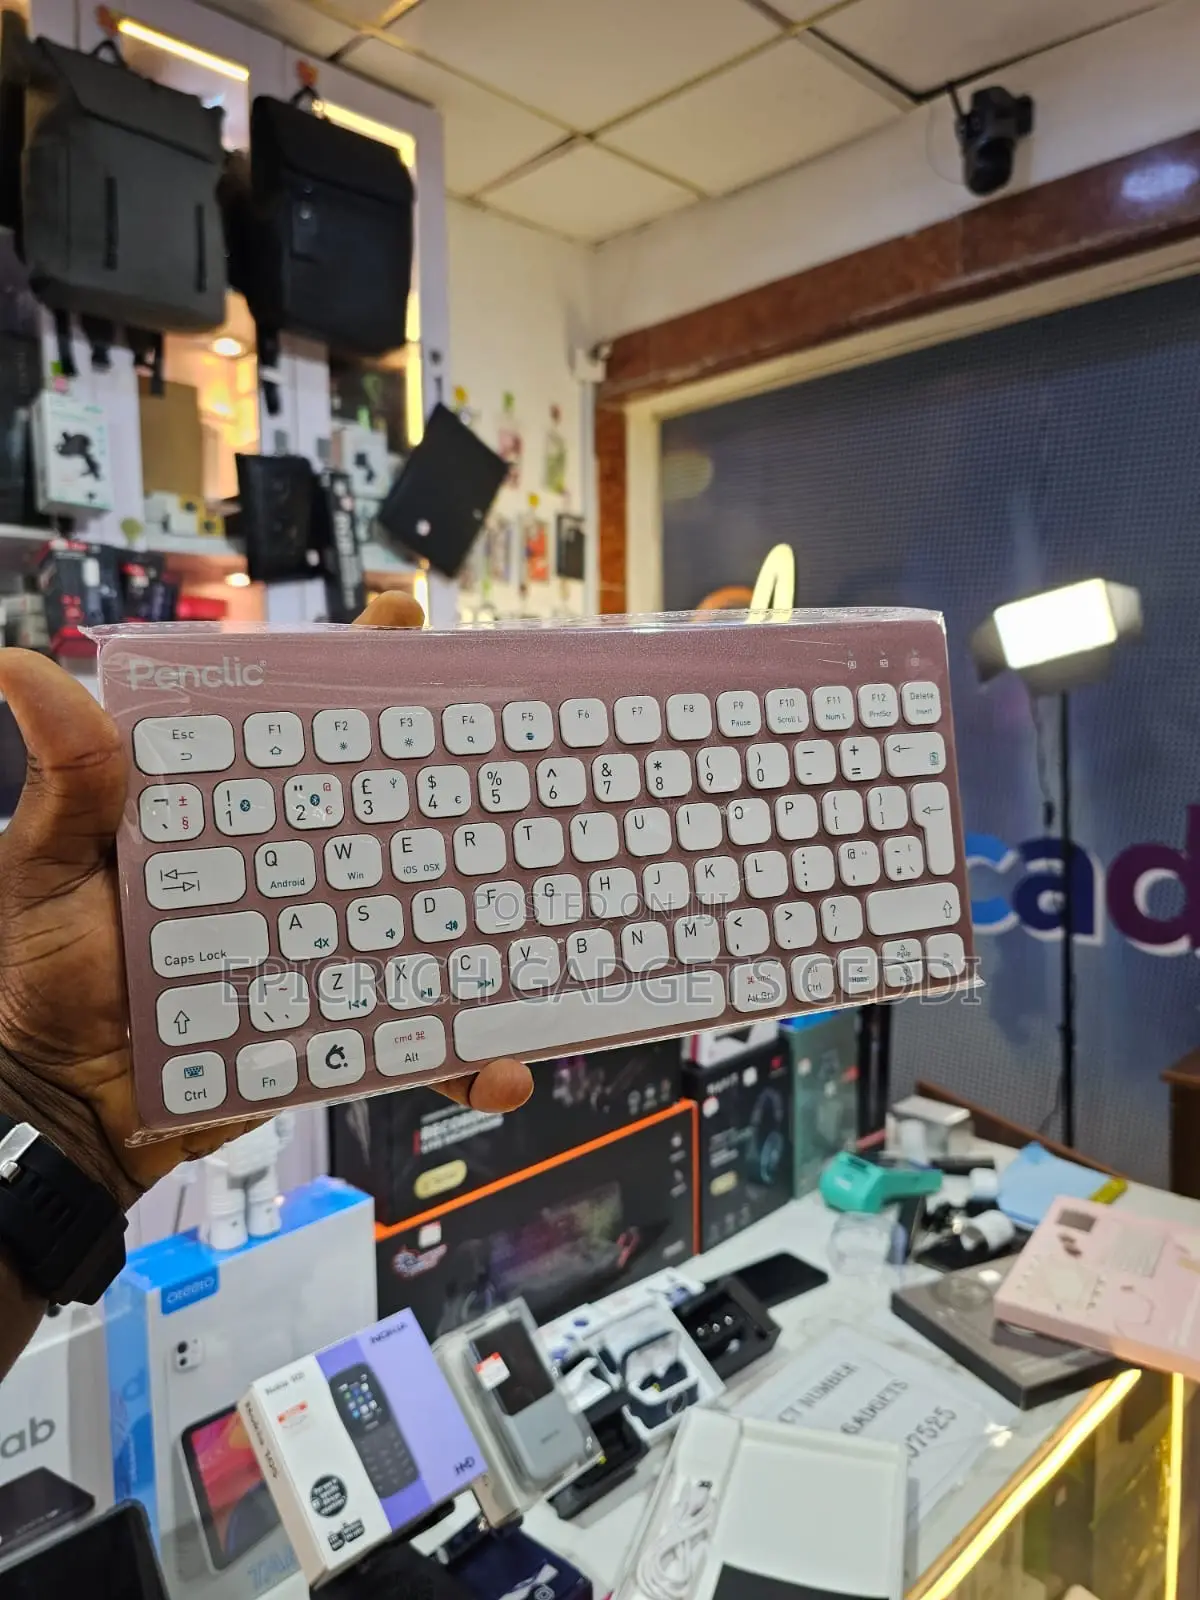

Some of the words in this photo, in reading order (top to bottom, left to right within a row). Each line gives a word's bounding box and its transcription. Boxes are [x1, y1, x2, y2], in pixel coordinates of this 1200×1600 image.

[779, 699, 795, 708] F10
[826, 696, 841, 704] F11
[871, 693, 886, 702] F12
[909, 692, 934, 701] Delete
[632, 707, 644, 716] F7
[683, 704, 694, 713] F8
[733, 701, 744, 710] F9
[462, 715, 475, 725] F4
[521, 712, 534, 722] F5
[578, 710, 590, 719] F6
[268, 724, 282, 735] F1
[335, 721, 348, 731] F2
[400, 718, 413, 728] F3
[731, 719, 752, 727] Pause
[172, 729, 194, 740] Esc
[849, 745, 859, 756] +
[547, 769, 557, 778] ^
[601, 763, 612, 777] &
[757, 769, 765, 782] 0
[851, 767, 861, 776] =
[428, 775, 437, 790] $
[487, 771, 502, 786] %
[655, 777, 664, 791] 8
[706, 773, 714, 786] 9
[361, 779, 372, 795] £
[549, 785, 557, 800] 6
[603, 781, 612, 795] 7
[226, 790, 231, 807] !
[428, 795, 438, 809] 4
[491, 789, 501, 804] 5
[295, 805, 306, 821] 2
[363, 800, 374, 816] 3
[734, 807, 744, 820] O
[785, 802, 794, 815] P
[225, 810, 233, 826] 1
[634, 815, 645, 830] U
[522, 825, 533, 841] T
[579, 820, 589, 835] Y
[401, 837, 413, 853] E
[464, 831, 476, 847] R
[334, 843, 352, 860] W
[847, 849, 856, 860] @
[264, 851, 278, 867] Q
[755, 859, 763, 873] L
[403, 865, 418, 875] iOS
[423, 862, 441, 873] OSX
[704, 863, 715, 879] K
[347, 871, 365, 881] Win
[654, 870, 661, 885] J
[270, 878, 305, 890] Android
[544, 883, 555, 898] G
[599, 876, 611, 892] H
[486, 889, 497, 905] F
[424, 897, 436, 913] D
[829, 904, 836, 917] ?
[358, 905, 370, 922] S
[784, 910, 793, 921] >
[289, 914, 303, 931] A
[734, 917, 743, 927] <
[684, 922, 697, 938] M
[632, 930, 644, 946] N
[577, 938, 588, 954] B
[164, 954, 195, 968] Caps
[199, 950, 228, 962] Lock
[520, 946, 531, 962] V
[460, 955, 471, 971] C
[395, 964, 408, 981] X
[332, 973, 344, 990] Z
[394, 1032, 412, 1044] cmd
[404, 1053, 419, 1064] Alt
[262, 1076, 276, 1088] Fn
[184, 1089, 207, 1102] Ctrl
[840, 1379, 909, 1435] GADGETS
